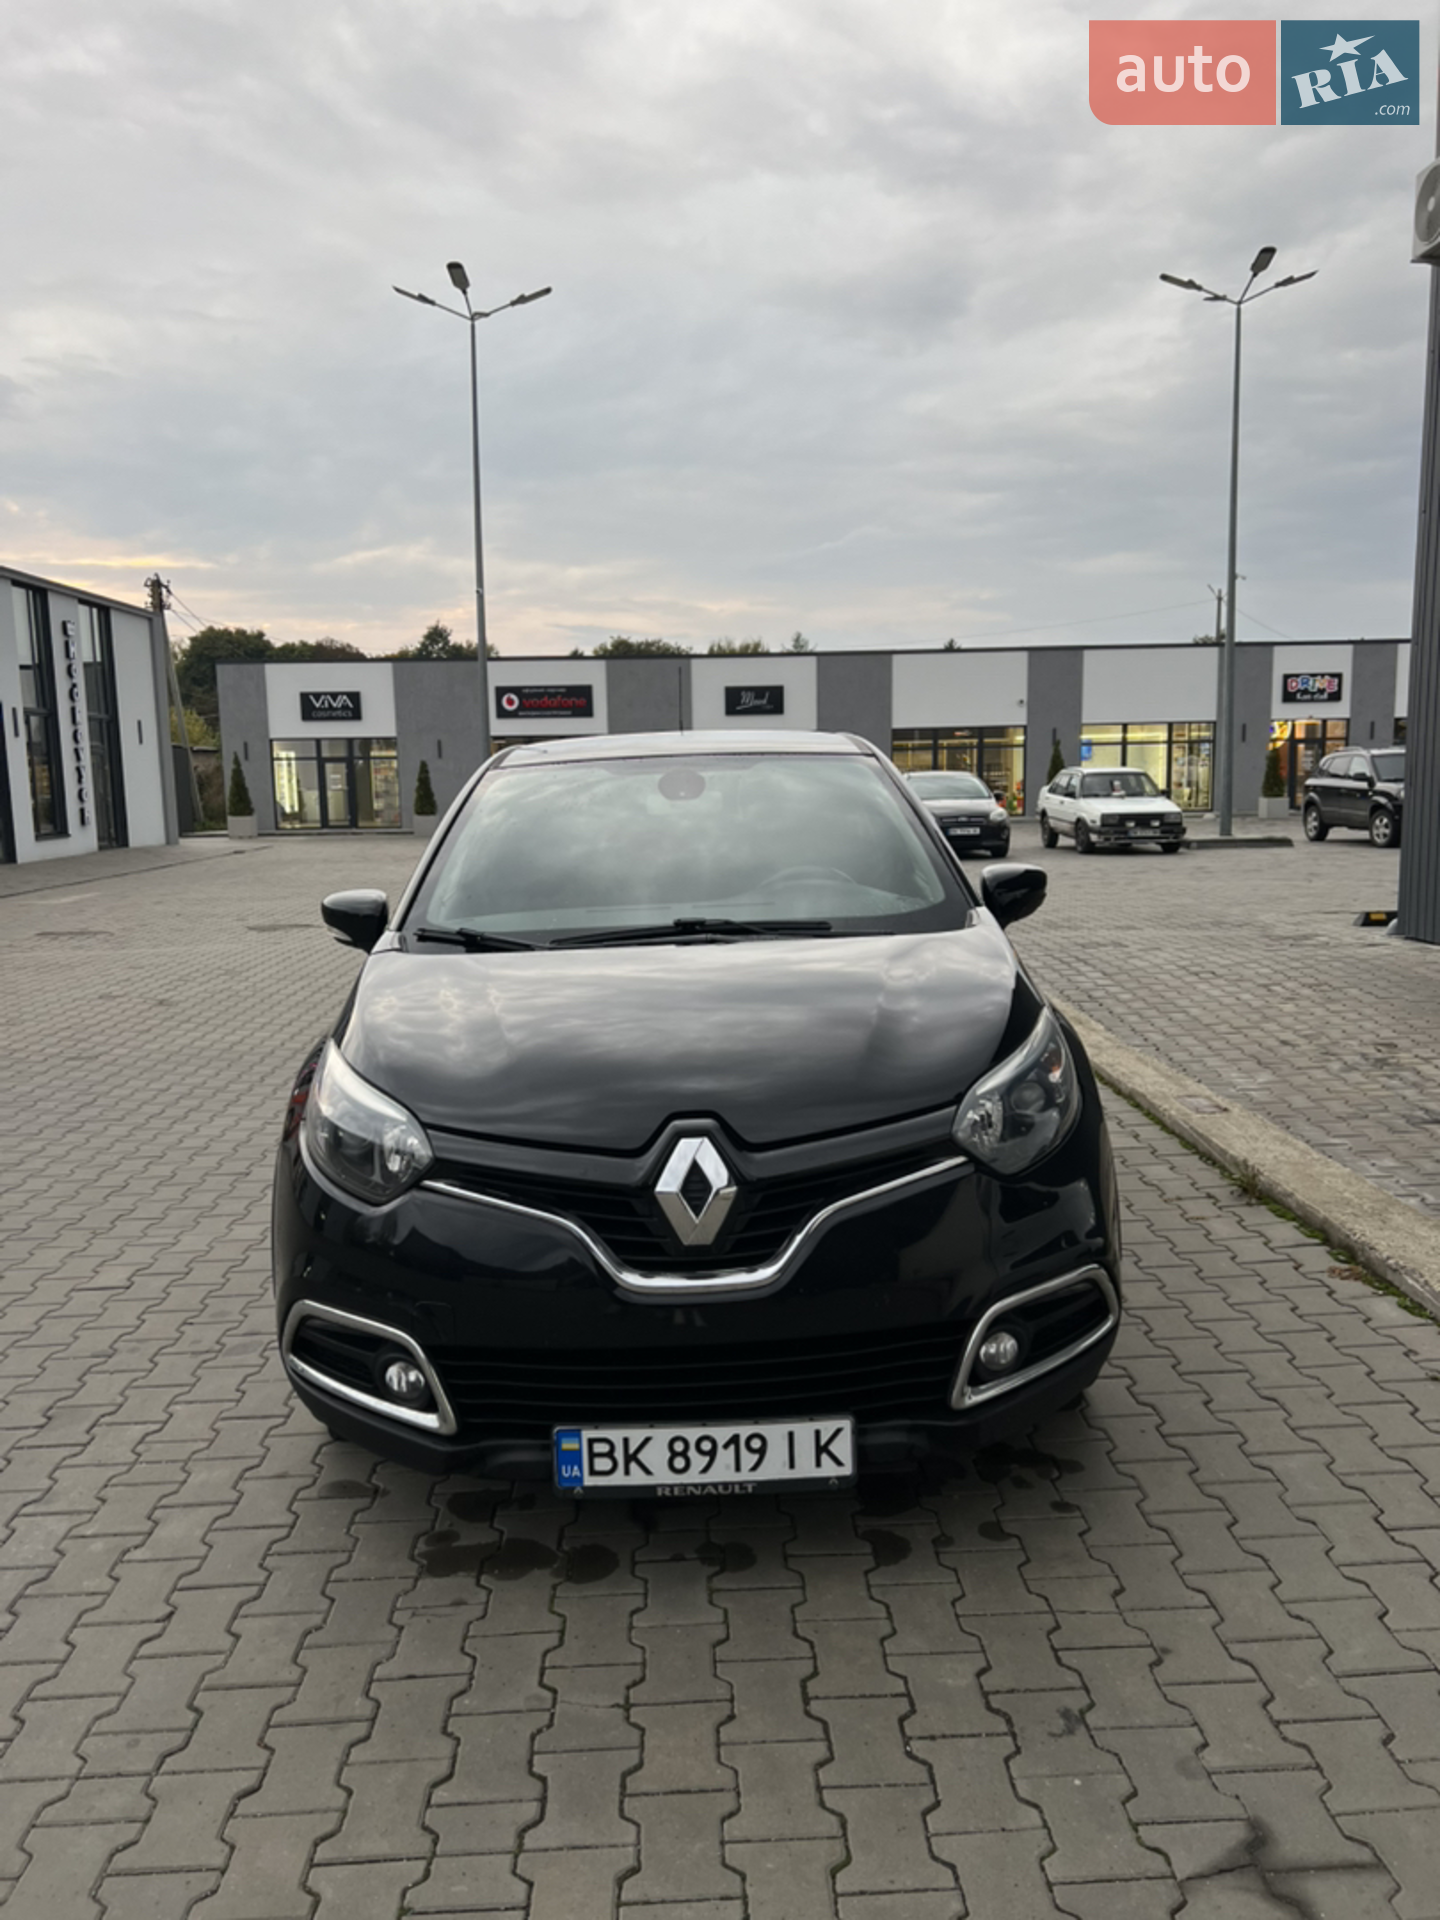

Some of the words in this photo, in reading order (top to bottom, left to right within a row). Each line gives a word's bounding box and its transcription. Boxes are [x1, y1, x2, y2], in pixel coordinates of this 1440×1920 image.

[1286, 675, 1339, 693] DRIVE
[522, 694, 588, 709] vodafone
[311, 710, 353, 719] cosmetics
[587, 1436, 654, 1477] BK
[667, 1431, 768, 1475] 8919
[561, 1465, 581, 1479] UA
[656, 1483, 758, 1497] RENAULT
